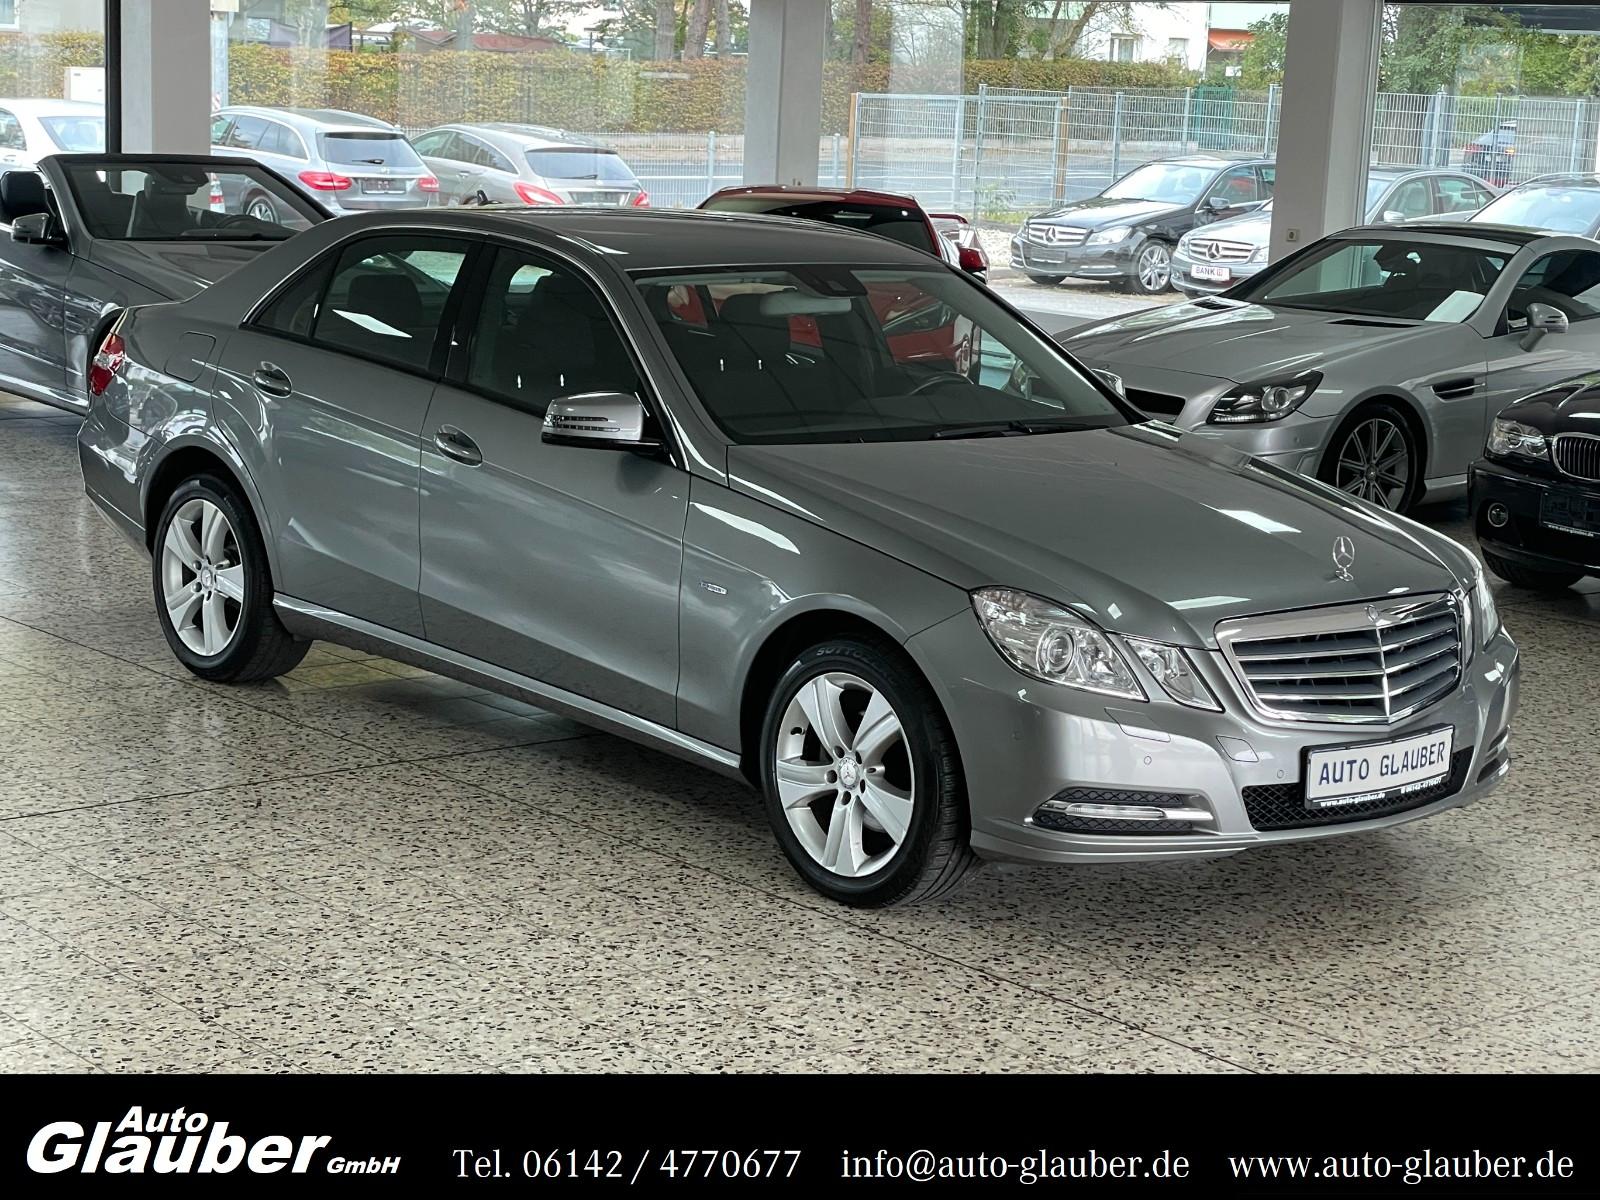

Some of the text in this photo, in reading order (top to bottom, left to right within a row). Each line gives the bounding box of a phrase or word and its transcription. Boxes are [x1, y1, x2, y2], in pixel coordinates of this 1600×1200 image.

[1195, 266, 1216, 276] BANK
[1318, 741, 1446, 786] AUTO GLAUBER
[1320, 792, 1386, 808] www.auto-glauber.de
